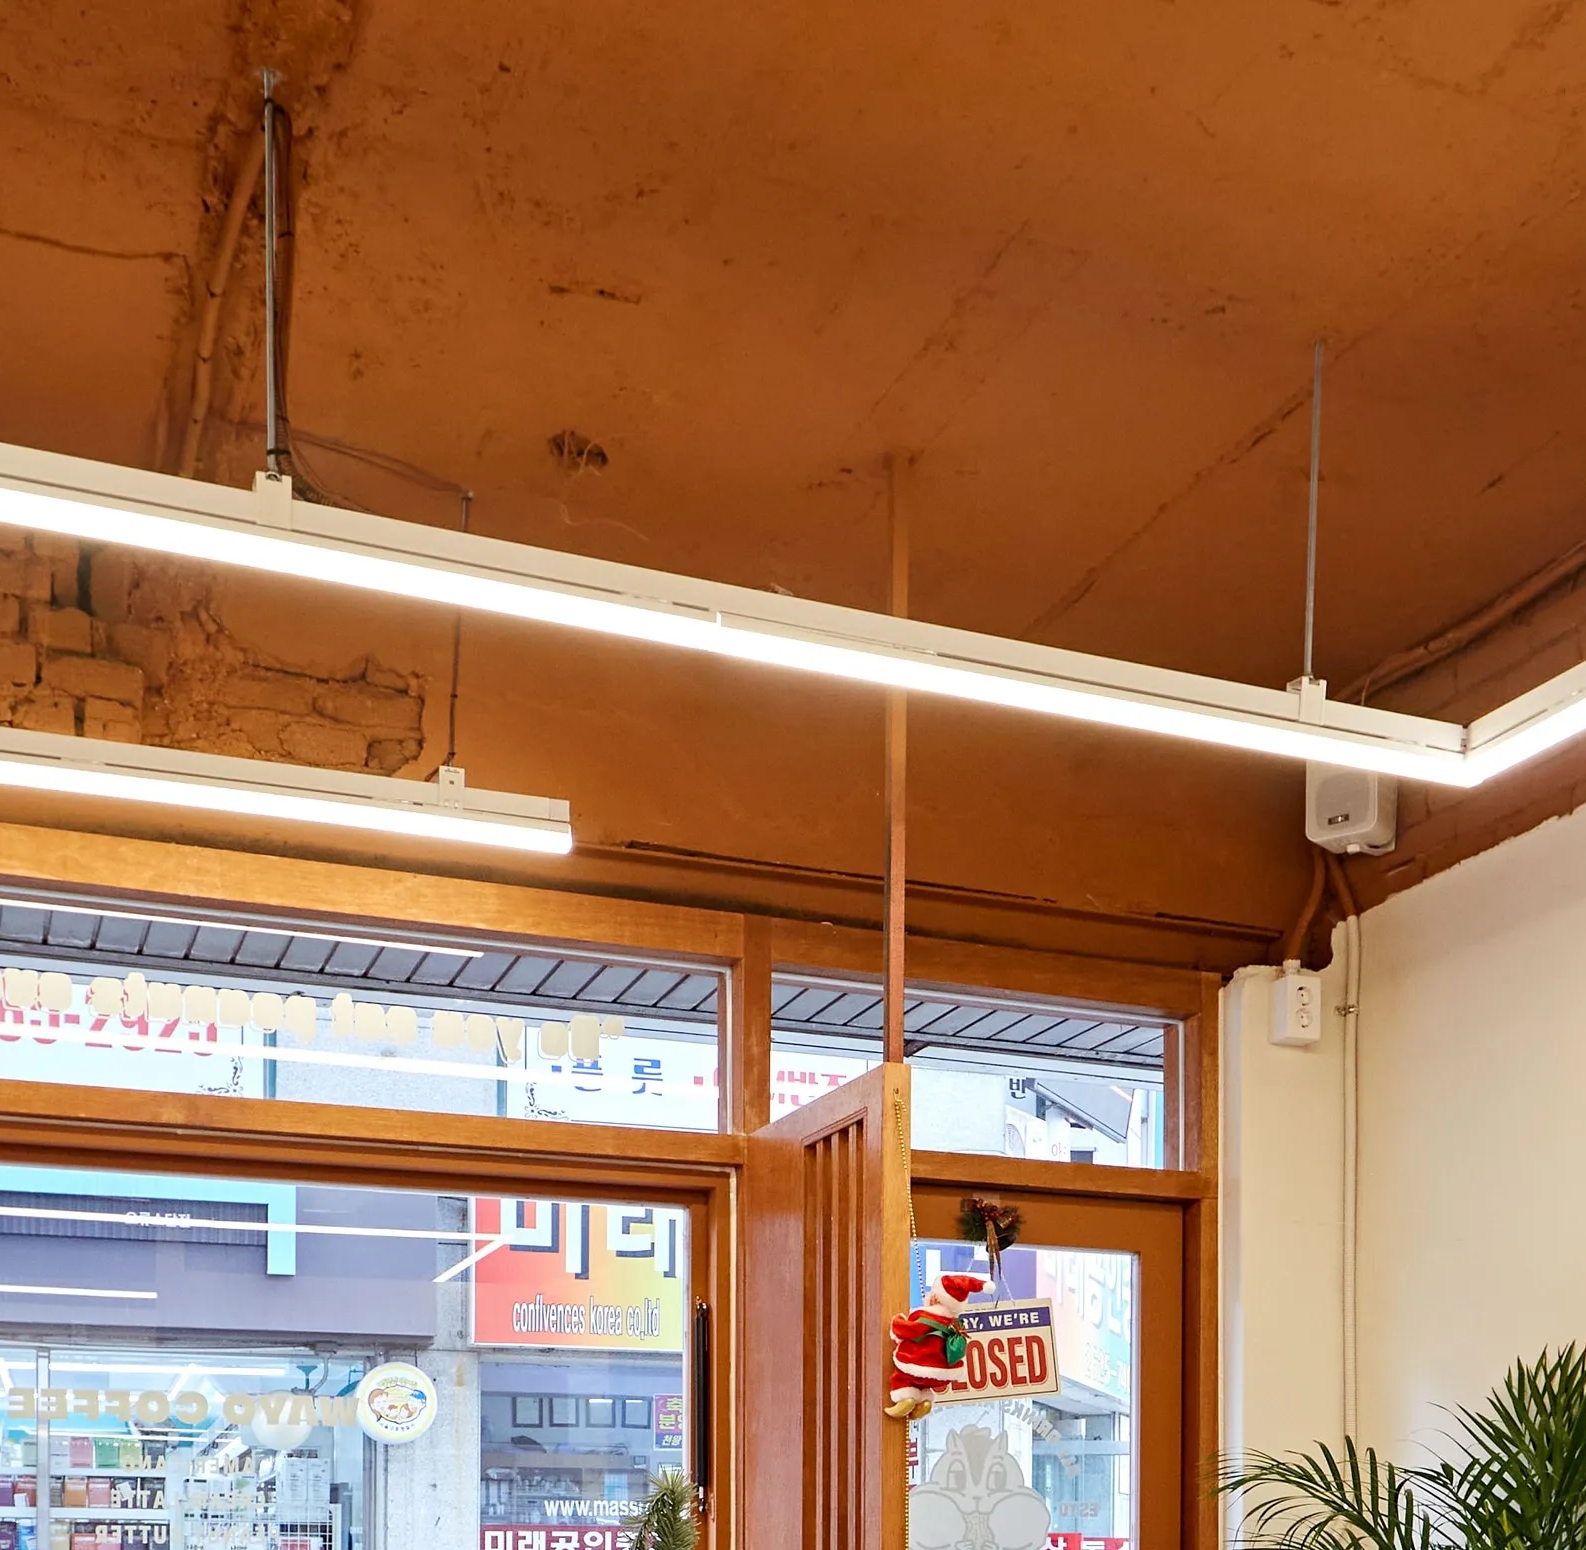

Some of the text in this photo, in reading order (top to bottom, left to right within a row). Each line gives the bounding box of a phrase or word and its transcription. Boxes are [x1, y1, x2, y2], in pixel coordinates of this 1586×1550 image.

[589, 1296, 622, 1335] korea
[989, 1311, 1040, 1328] WE'RE
[932, 1334, 1049, 1393] OSED
